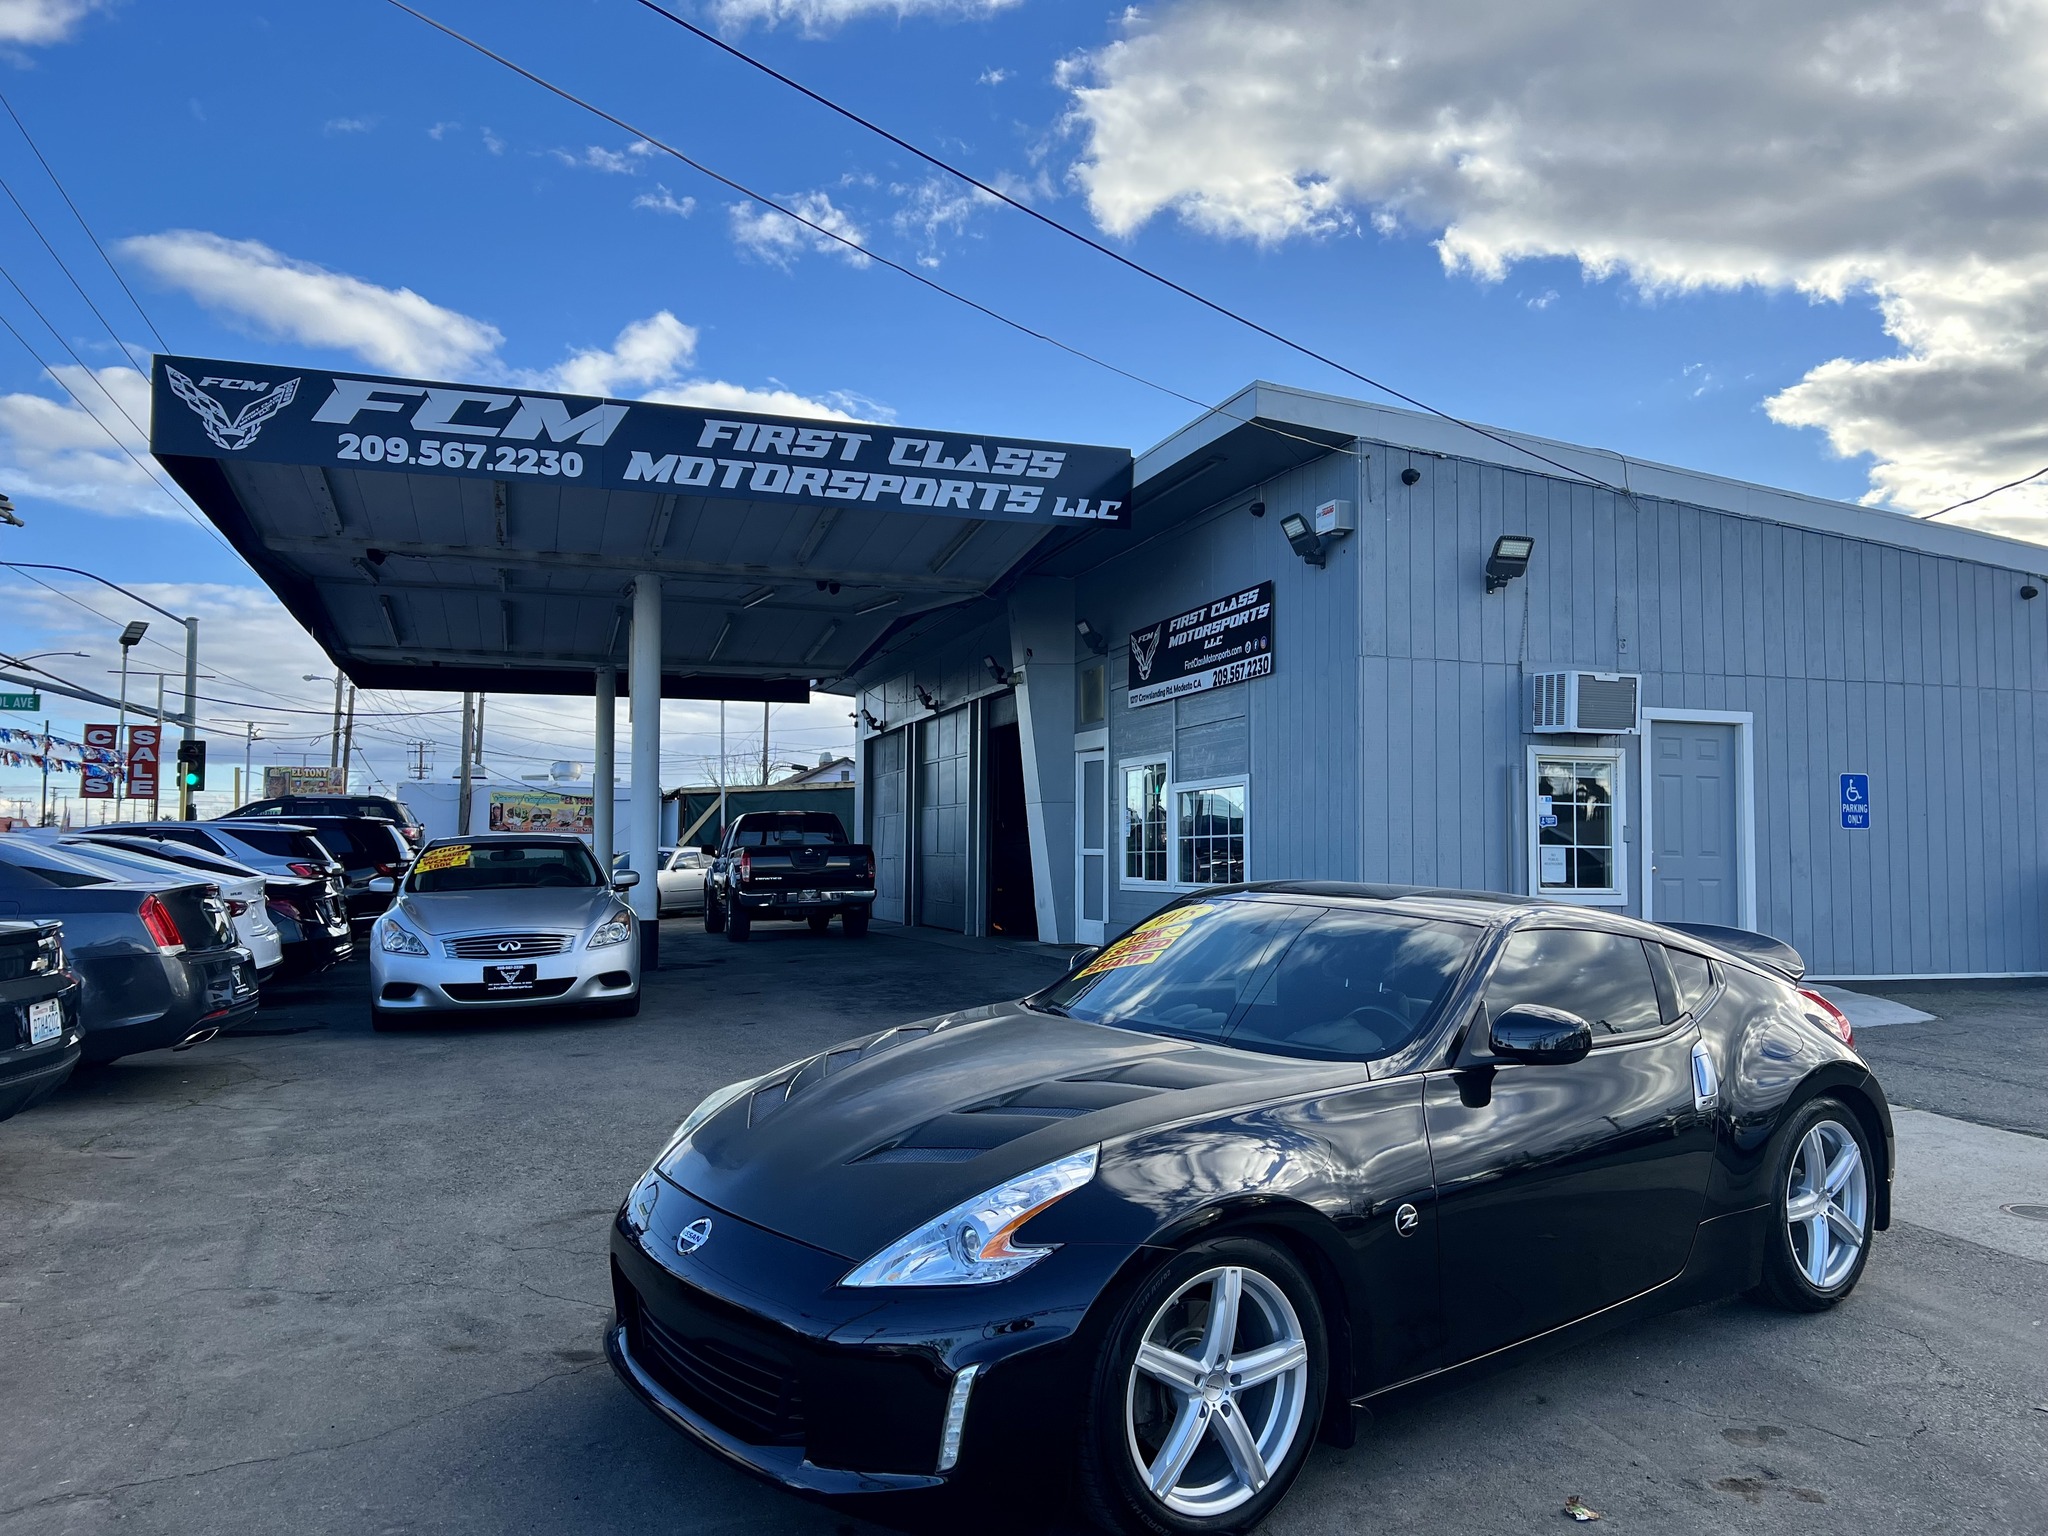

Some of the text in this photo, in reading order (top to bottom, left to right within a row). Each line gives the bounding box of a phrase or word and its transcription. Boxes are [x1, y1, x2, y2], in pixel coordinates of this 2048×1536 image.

[198, 376, 269, 392] FCM
[311, 378, 631, 446] FCM
[336, 433, 584, 478] 209.567.2230
[697, 418, 1067, 479] FIRST CLASS
[622, 450, 1122, 520] MOTORSPORTS LLC
[1169, 588, 1260, 633] FIRST CLASS
[1168, 602, 1271, 649] MOTORSPORTS
[1204, 635, 1223, 650] LLC
[1212, 655, 1270, 688] 209.567.2230
[1173, 682, 1193, 693] Modesto
[1193, 679, 1202, 689] CA
[13, 697, 33, 708] AVE
[130, 730, 157, 795] SALE
[291, 768, 302, 778] EL
[304, 768, 329, 778] TONY
[1842, 803, 1868, 813] PARKING
[1847, 814, 1863, 824] ONLY
[1110, 939, 1173, 958] SPEED
[1083, 953, 1154, 976] SHARP
